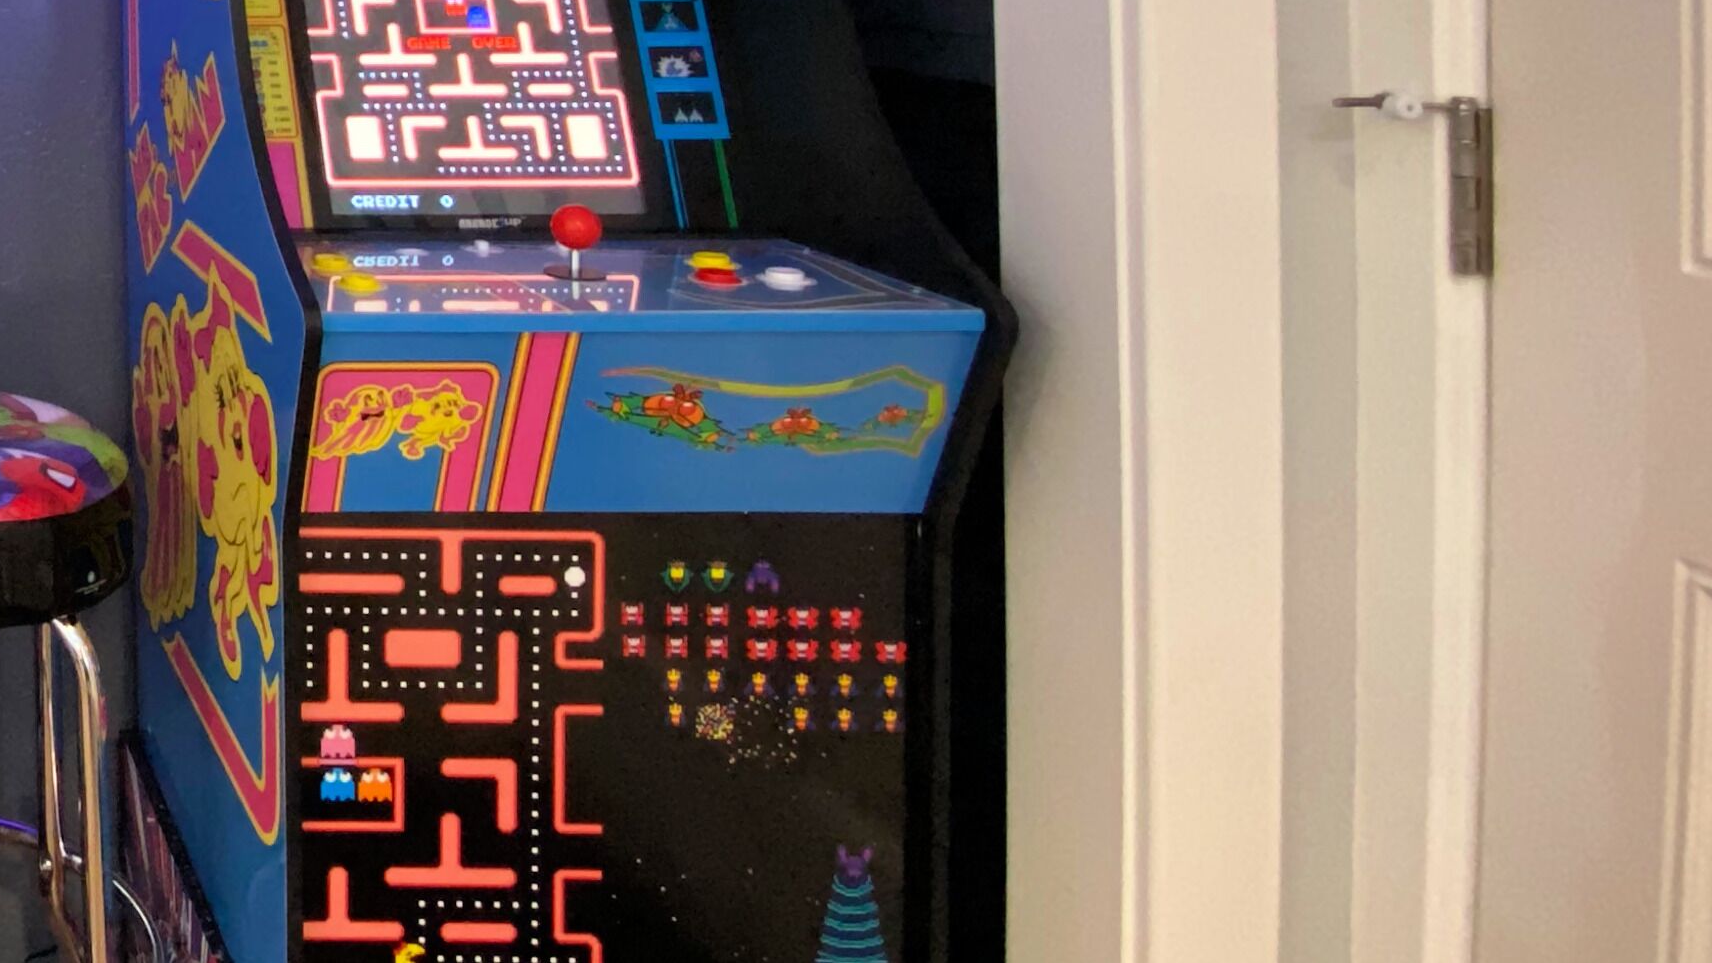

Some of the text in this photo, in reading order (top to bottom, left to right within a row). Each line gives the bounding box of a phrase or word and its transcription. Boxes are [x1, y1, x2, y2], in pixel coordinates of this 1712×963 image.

[407, 36, 518, 50] GAME OVER
[351, 195, 454, 209] CREDIT 0
